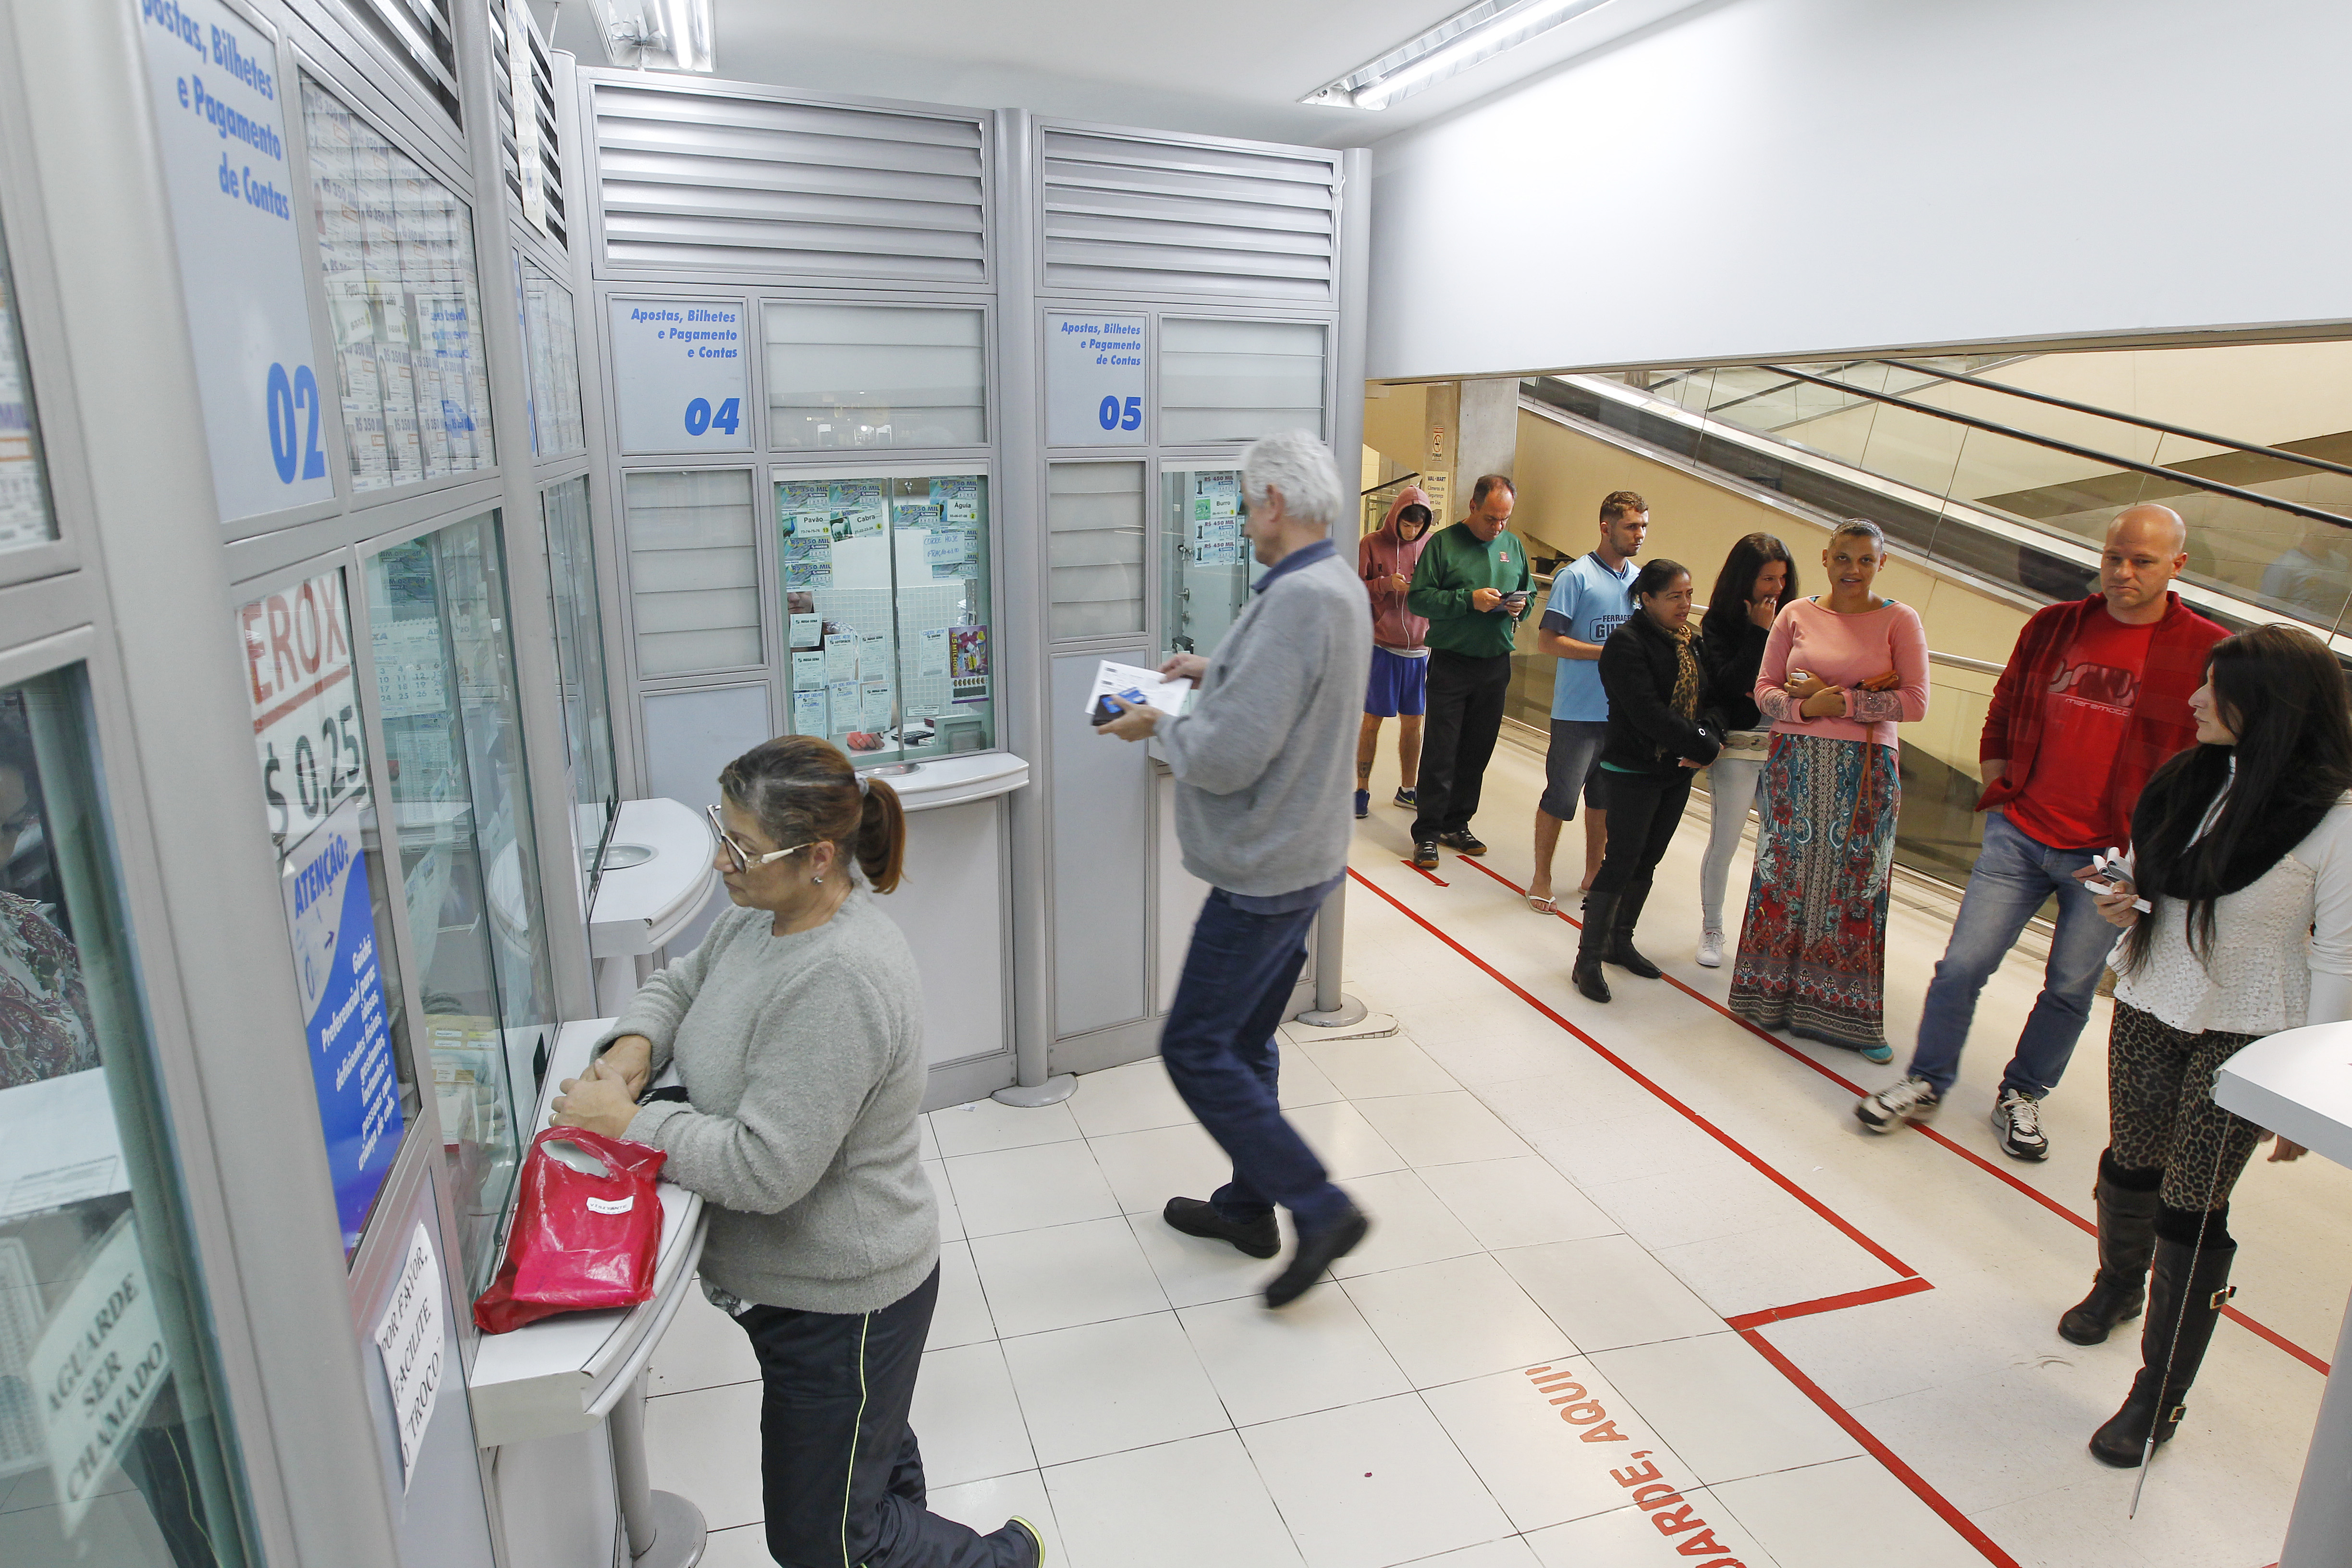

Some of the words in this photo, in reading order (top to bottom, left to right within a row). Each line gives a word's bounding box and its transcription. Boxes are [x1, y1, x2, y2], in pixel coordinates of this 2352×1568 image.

[211, 23, 273, 101] Bilhetes
[177, 76, 189, 109] e
[192, 73, 281, 161] Pagamento
[219, 151, 239, 199] de
[243, 166, 289, 220] Contas
[631, 308, 683, 323] Apostas,
[687, 309, 736, 322] Bilhetes
[658, 330, 665, 339] e
[669, 328, 737, 343] Pagamento
[1061, 322, 1101, 335] Apostas,
[1103, 323, 1140, 334] Bilhetes
[687, 349, 695, 357] e
[699, 346, 737, 358] Contas
[1089, 339, 1141, 351] Pagamento
[1096, 354, 1108, 365] de
[1111, 355, 1141, 365] Contas
[267, 362, 326, 484] 02
[684, 397, 740, 436] 04
[1099, 395, 1141, 431] 05
[857, 514, 875, 522] Cabra
[243, 571, 347, 706] EROX
[2066, 698, 2131, 717] maremoto
[294, 705, 361, 820] 0,25
[294, 831, 349, 920] ATENÇÃO:
[352, 933, 372, 975] Guichê
[321, 978, 360, 1053] Preferencial
[360, 964, 375, 1001] para:
[361, 990, 379, 1023] idosos,
[336, 1036, 366, 1092] deficientes
[360, 1033, 385, 1086] gestantes,
[361, 1059, 385, 1107] lactantes
[384, 1053, 389, 1066] e
[362, 1091, 383, 1140] pessoas
[382, 1074, 392, 1099] com
[358, 1129, 377, 1171] criança
[377, 1114, 384, 1136] de
[398, 1246, 429, 1319] FAVOR,
[50, 1271, 139, 1411] AGUARDE
[394, 1297, 432, 1405] FACILITE
[84, 1350, 122, 1419] SER
[67, 1341, 164, 1501] CHAMADO
[403, 1442, 410, 1468] O
